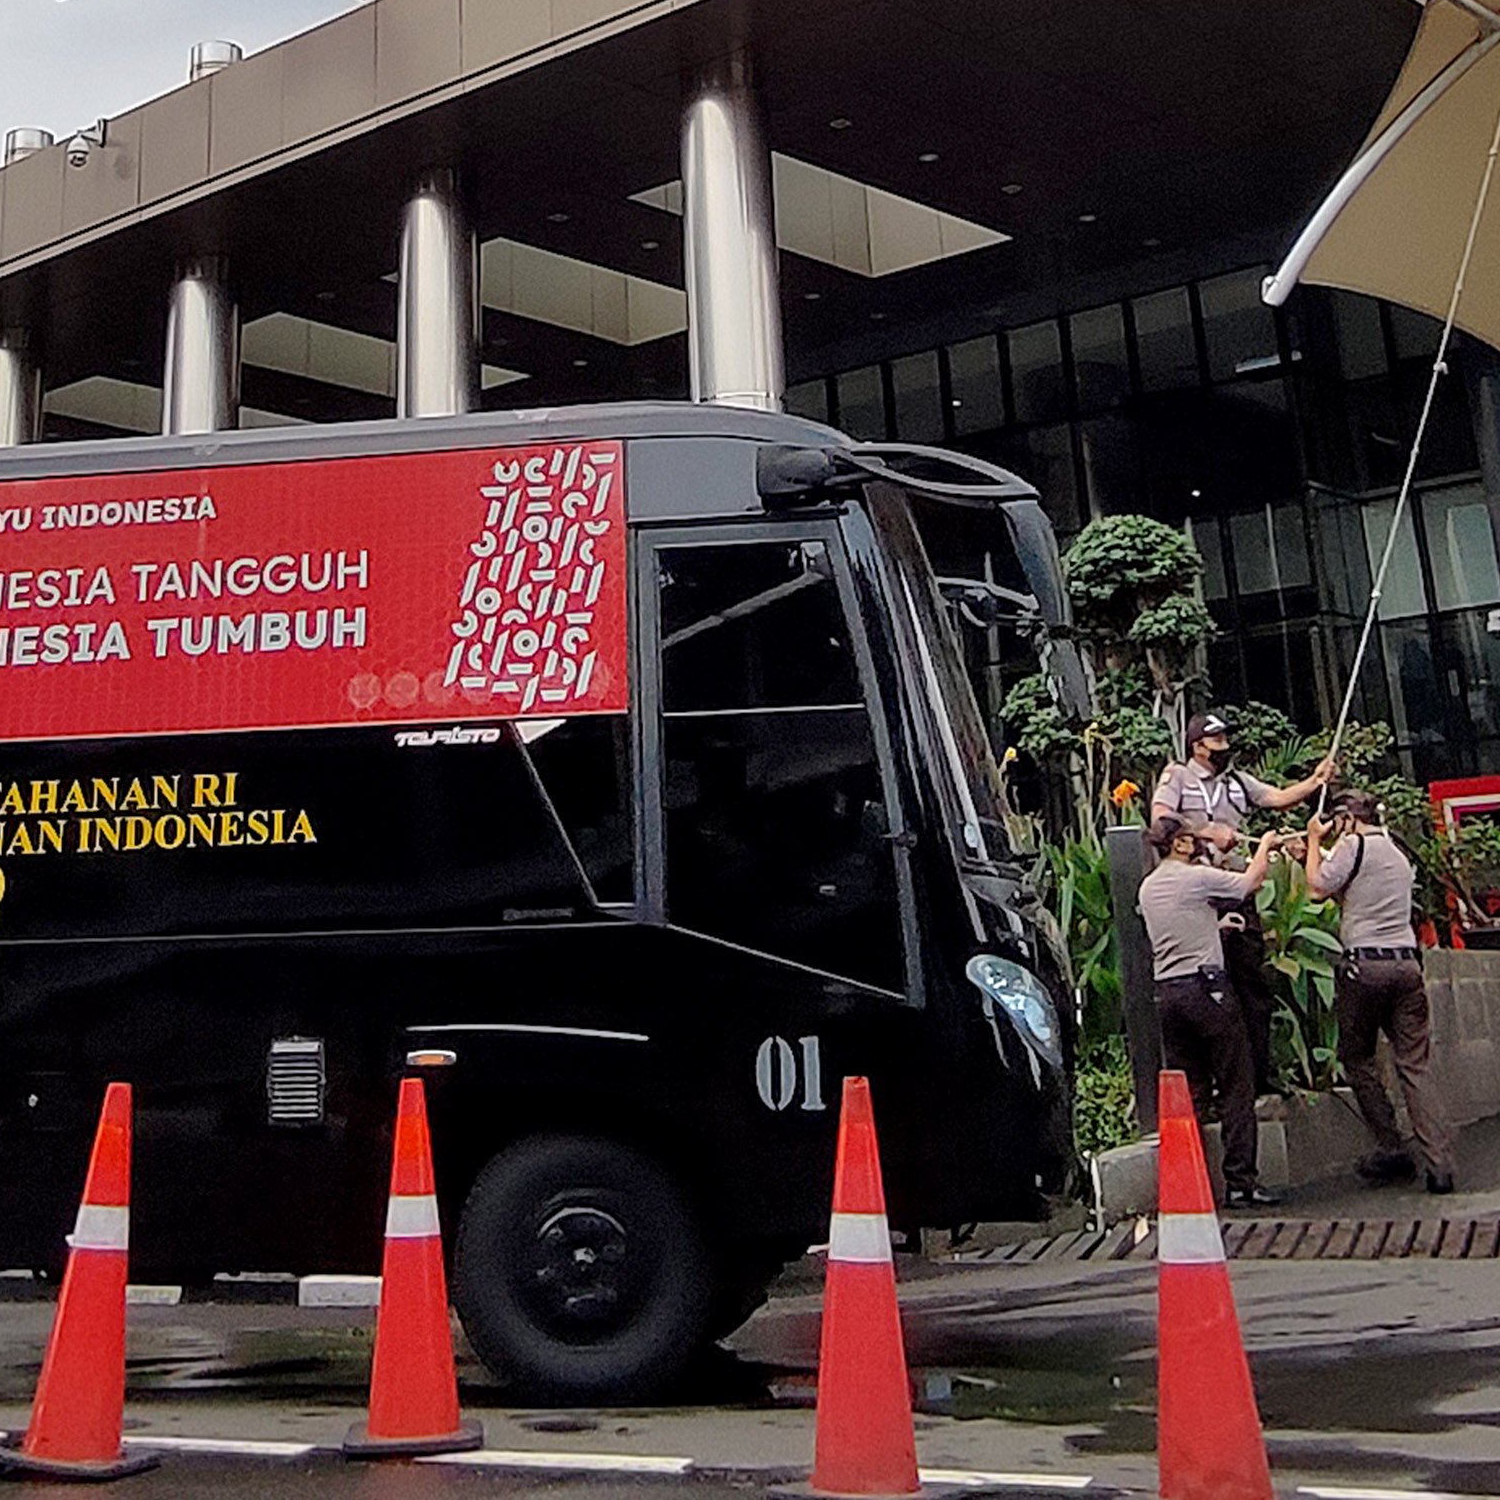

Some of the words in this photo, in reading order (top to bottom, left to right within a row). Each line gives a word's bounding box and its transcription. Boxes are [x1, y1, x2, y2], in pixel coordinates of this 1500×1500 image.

[40, 496, 217, 531] INDONESIA
[131, 549, 369, 602] TANGGUH
[146, 606, 367, 658] TUMBUH
[190, 772, 239, 808] RI
[76, 809, 318, 853] INDONESIA
[755, 1035, 827, 1111] 01
